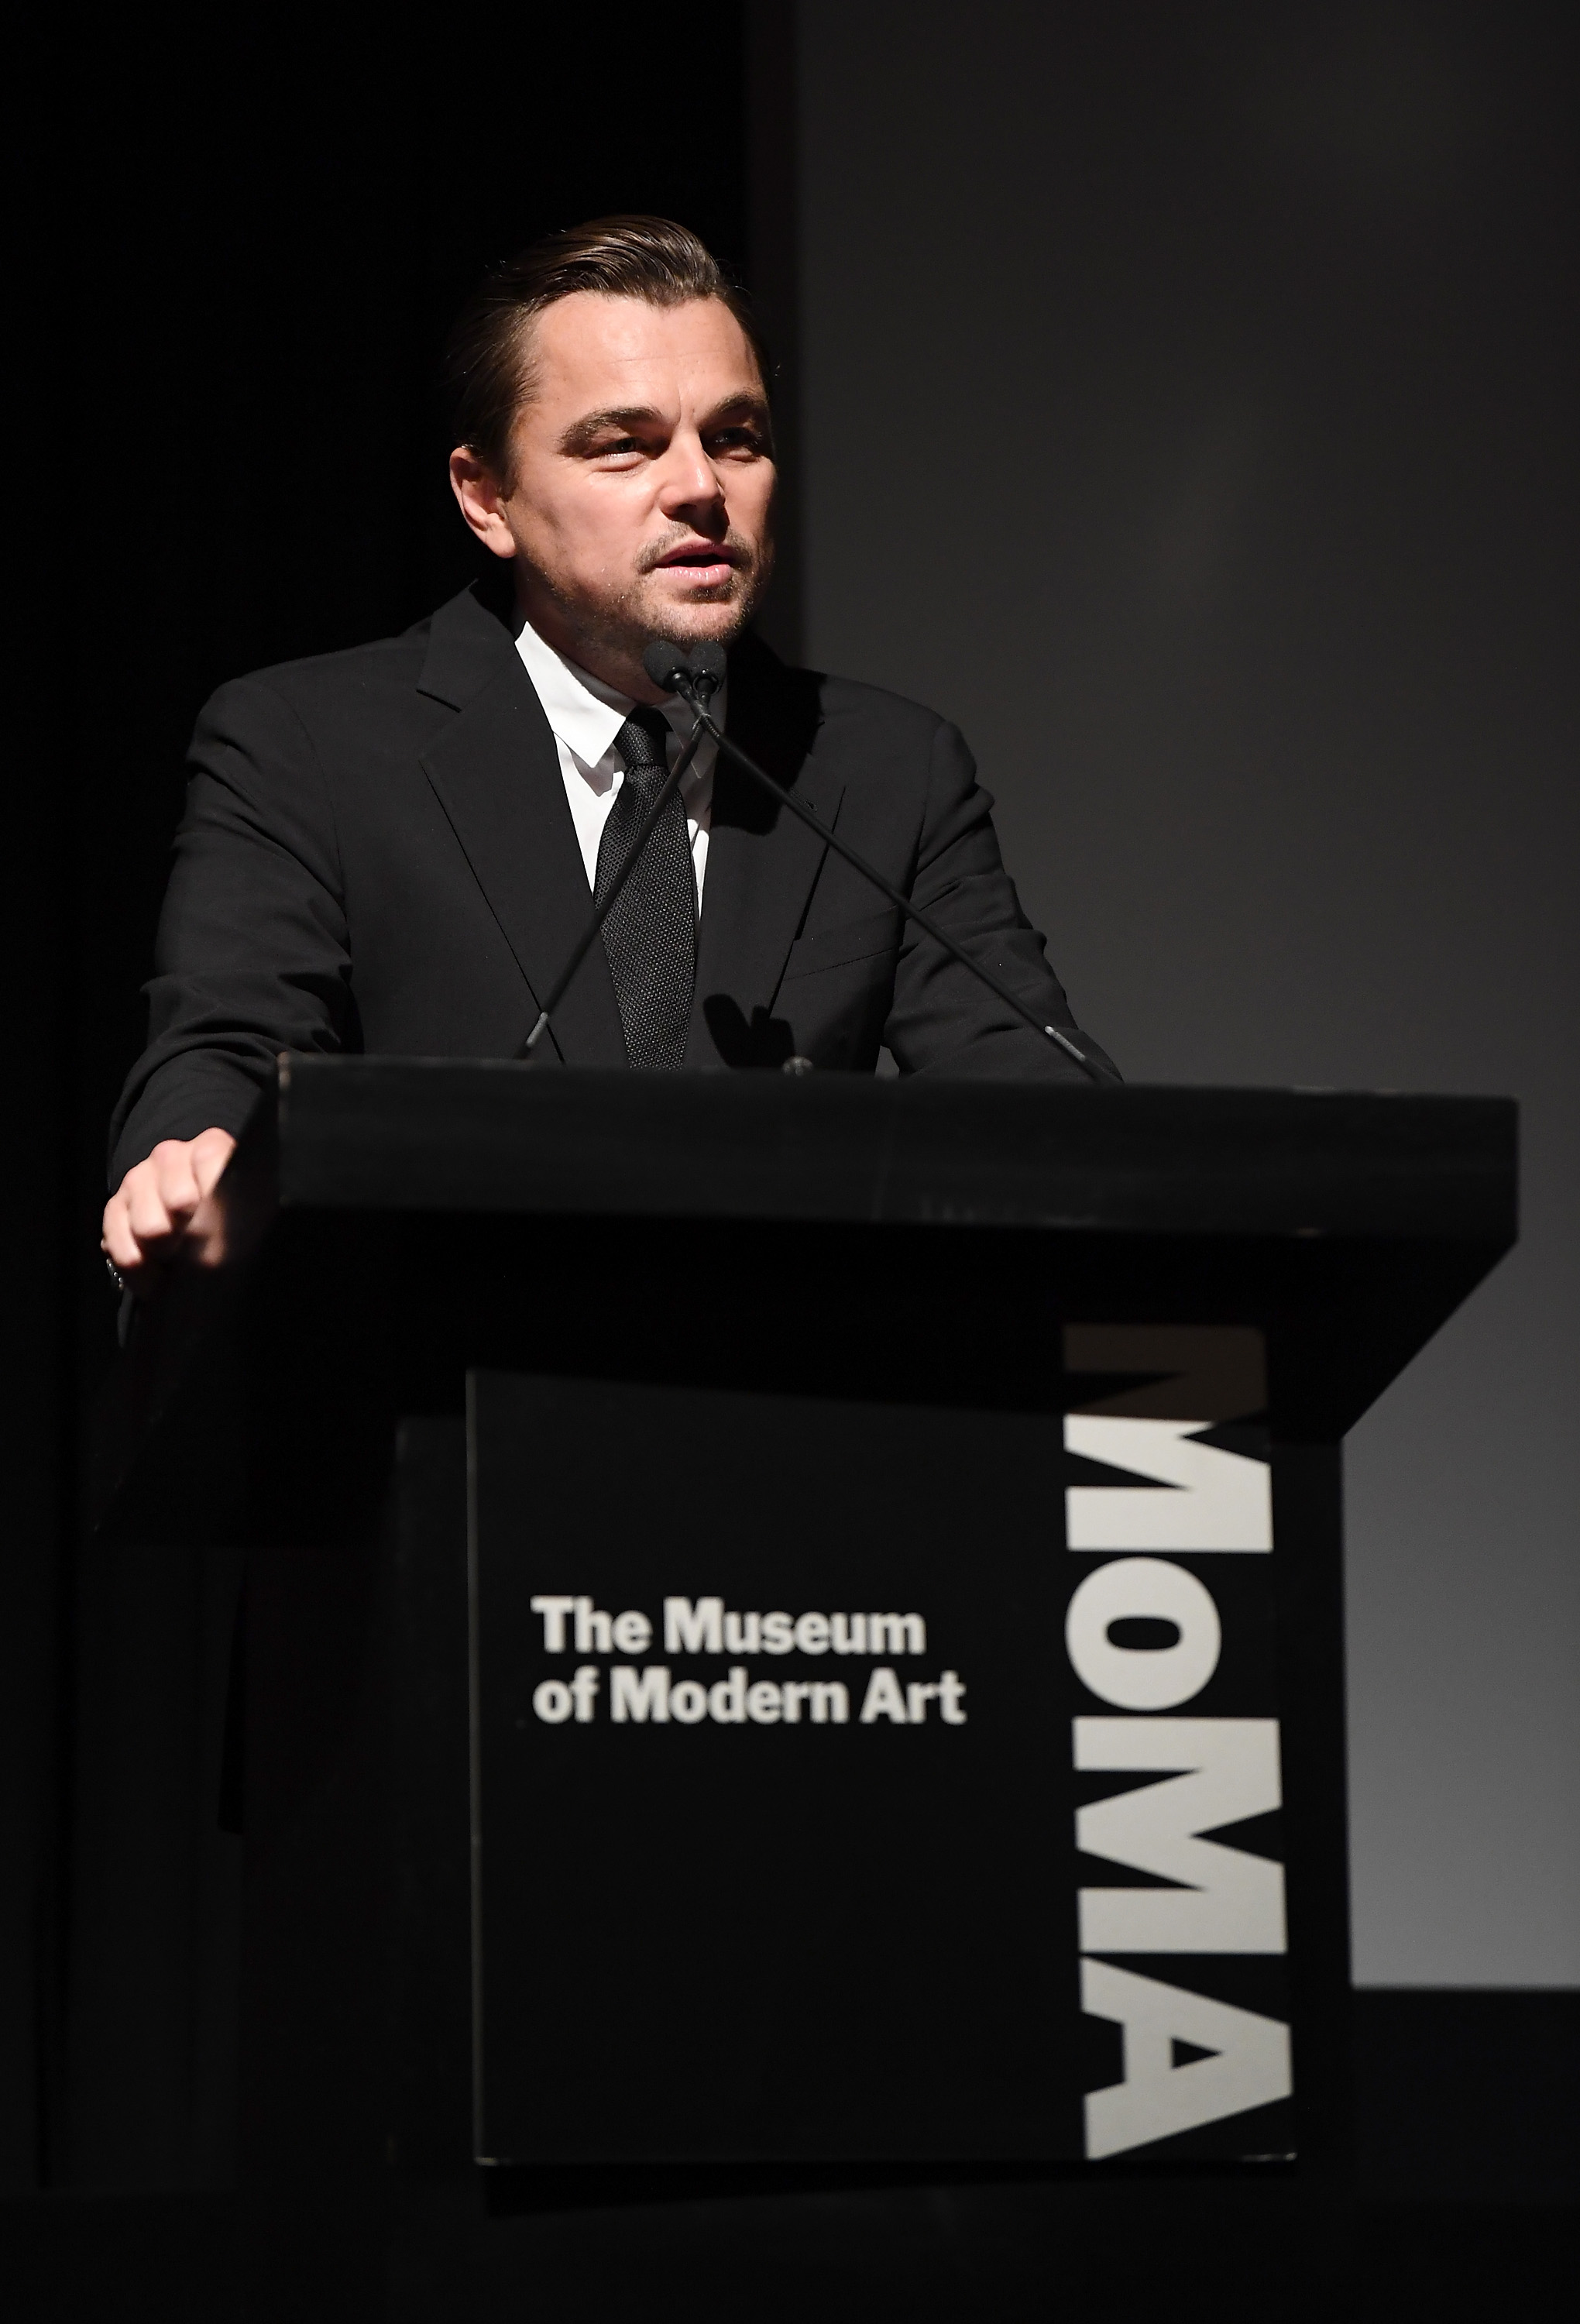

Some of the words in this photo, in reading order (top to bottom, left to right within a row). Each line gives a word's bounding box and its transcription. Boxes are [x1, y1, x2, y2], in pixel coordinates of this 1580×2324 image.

[531, 1596, 652, 1654] The
[664, 1597, 926, 1655] Museum
[533, 1666, 599, 1724] of
[610, 1666, 849, 1724] Modern
[860, 1668, 967, 1724] Art
[1062, 1322, 1292, 2159] MoMA
